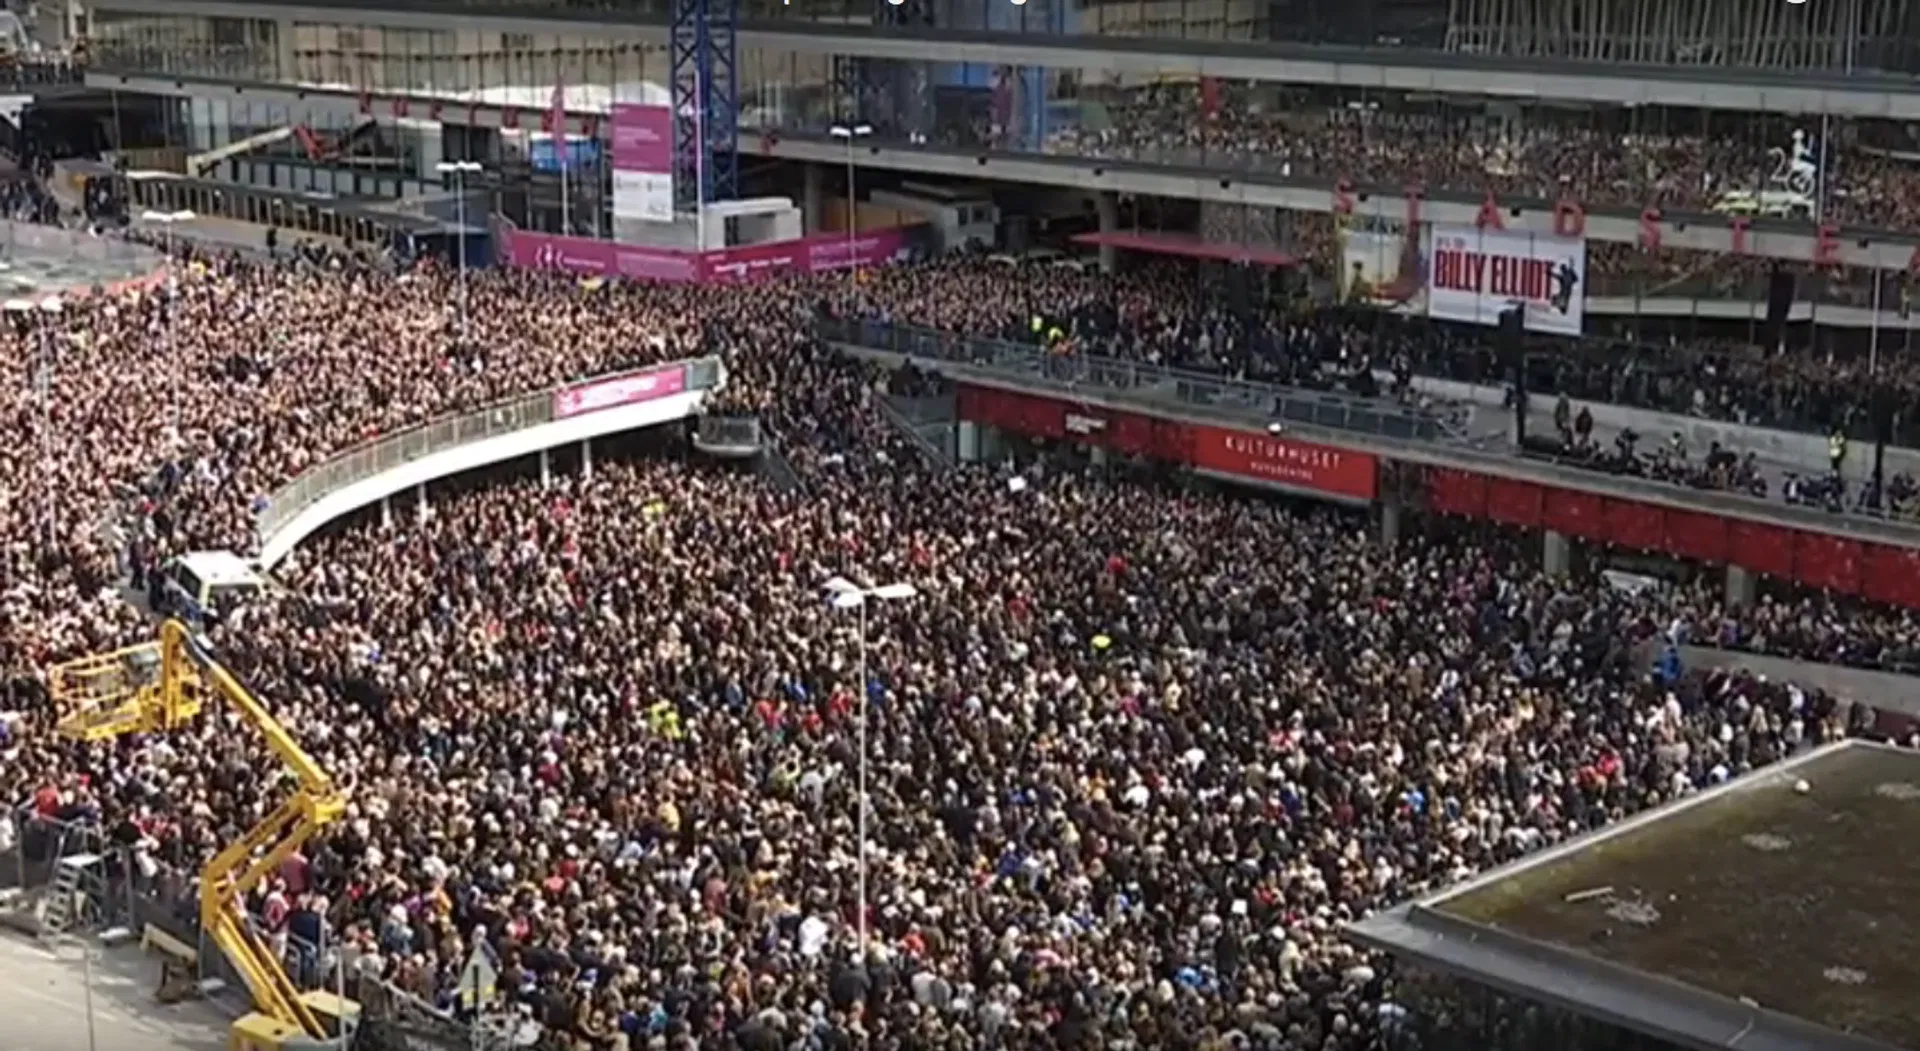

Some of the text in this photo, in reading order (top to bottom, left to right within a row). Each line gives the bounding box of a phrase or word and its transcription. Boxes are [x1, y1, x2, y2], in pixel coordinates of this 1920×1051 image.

[1434, 249, 1556, 301] BILLY ELLIOT
[1225, 435, 1341, 469] KULTURHUSET
